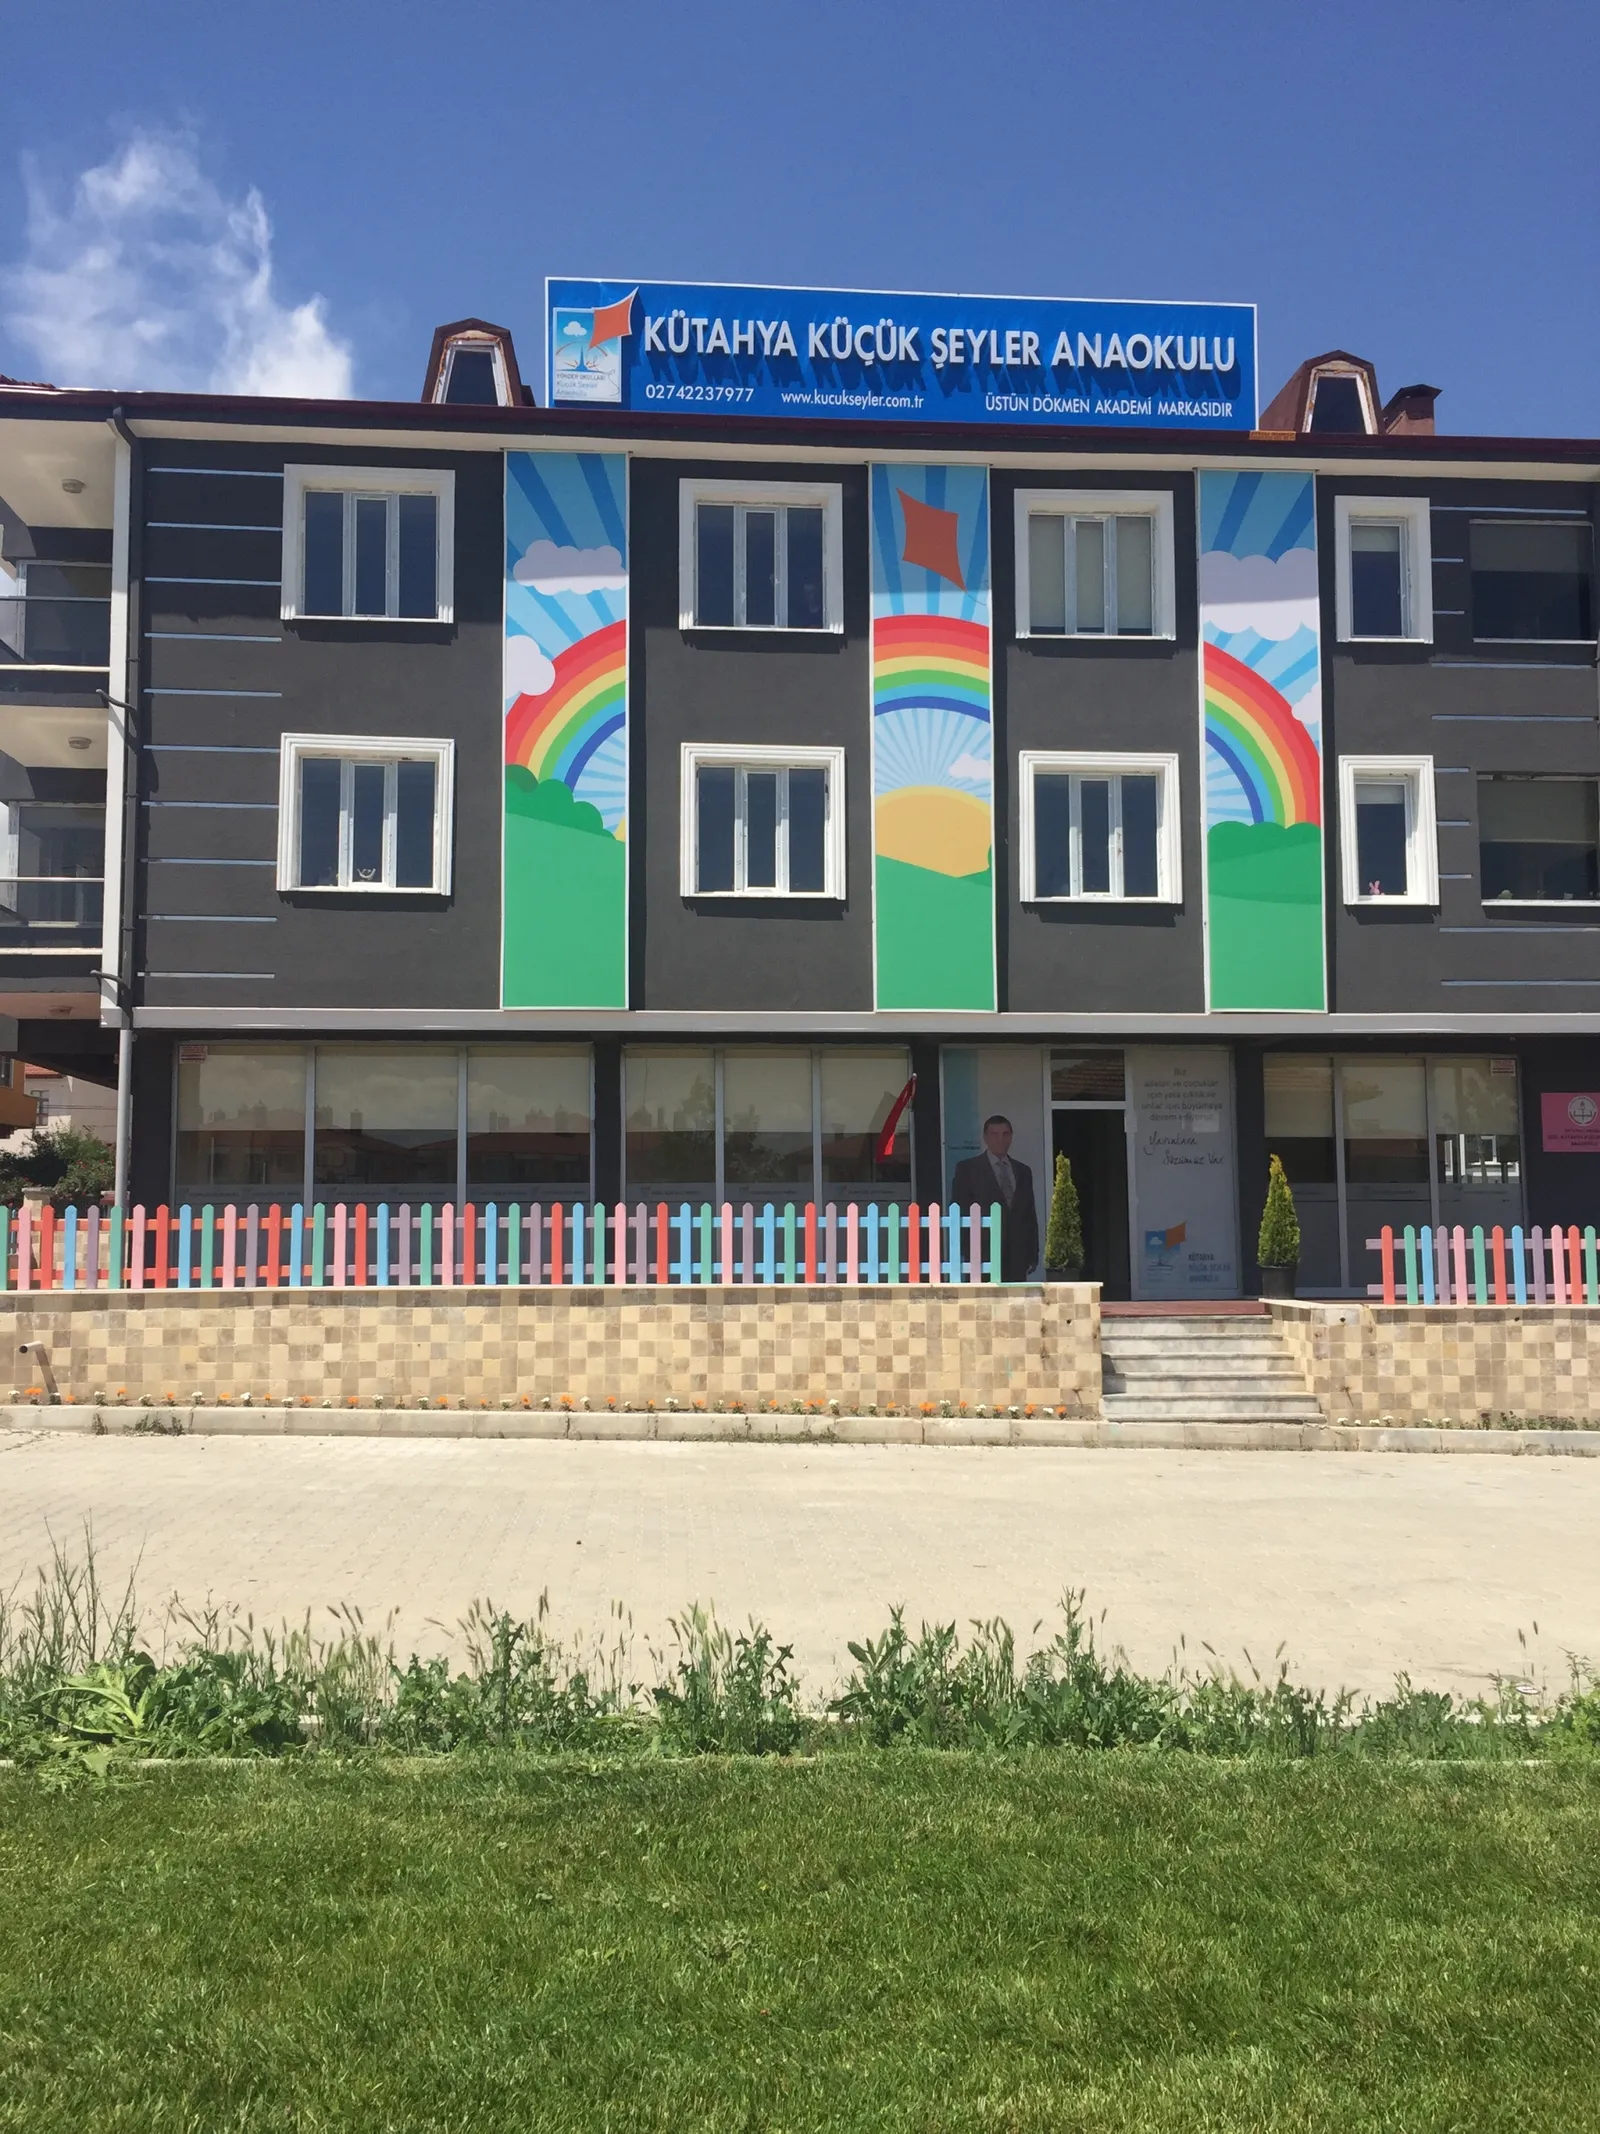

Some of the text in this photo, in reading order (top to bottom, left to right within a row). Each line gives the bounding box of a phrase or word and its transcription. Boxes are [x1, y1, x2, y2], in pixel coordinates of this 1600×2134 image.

[644, 308, 1235, 372] KÜTAHYA KÜÇÜK ŞEYLER ANAOKULU
[645, 384, 755, 402] 02742237977
[781, 389, 924, 409] www.kucukseyler.com.tr
[985, 392, 1233, 418] ÜSTÜN DÖKMEN AKADEMİ MARKASIDIR
